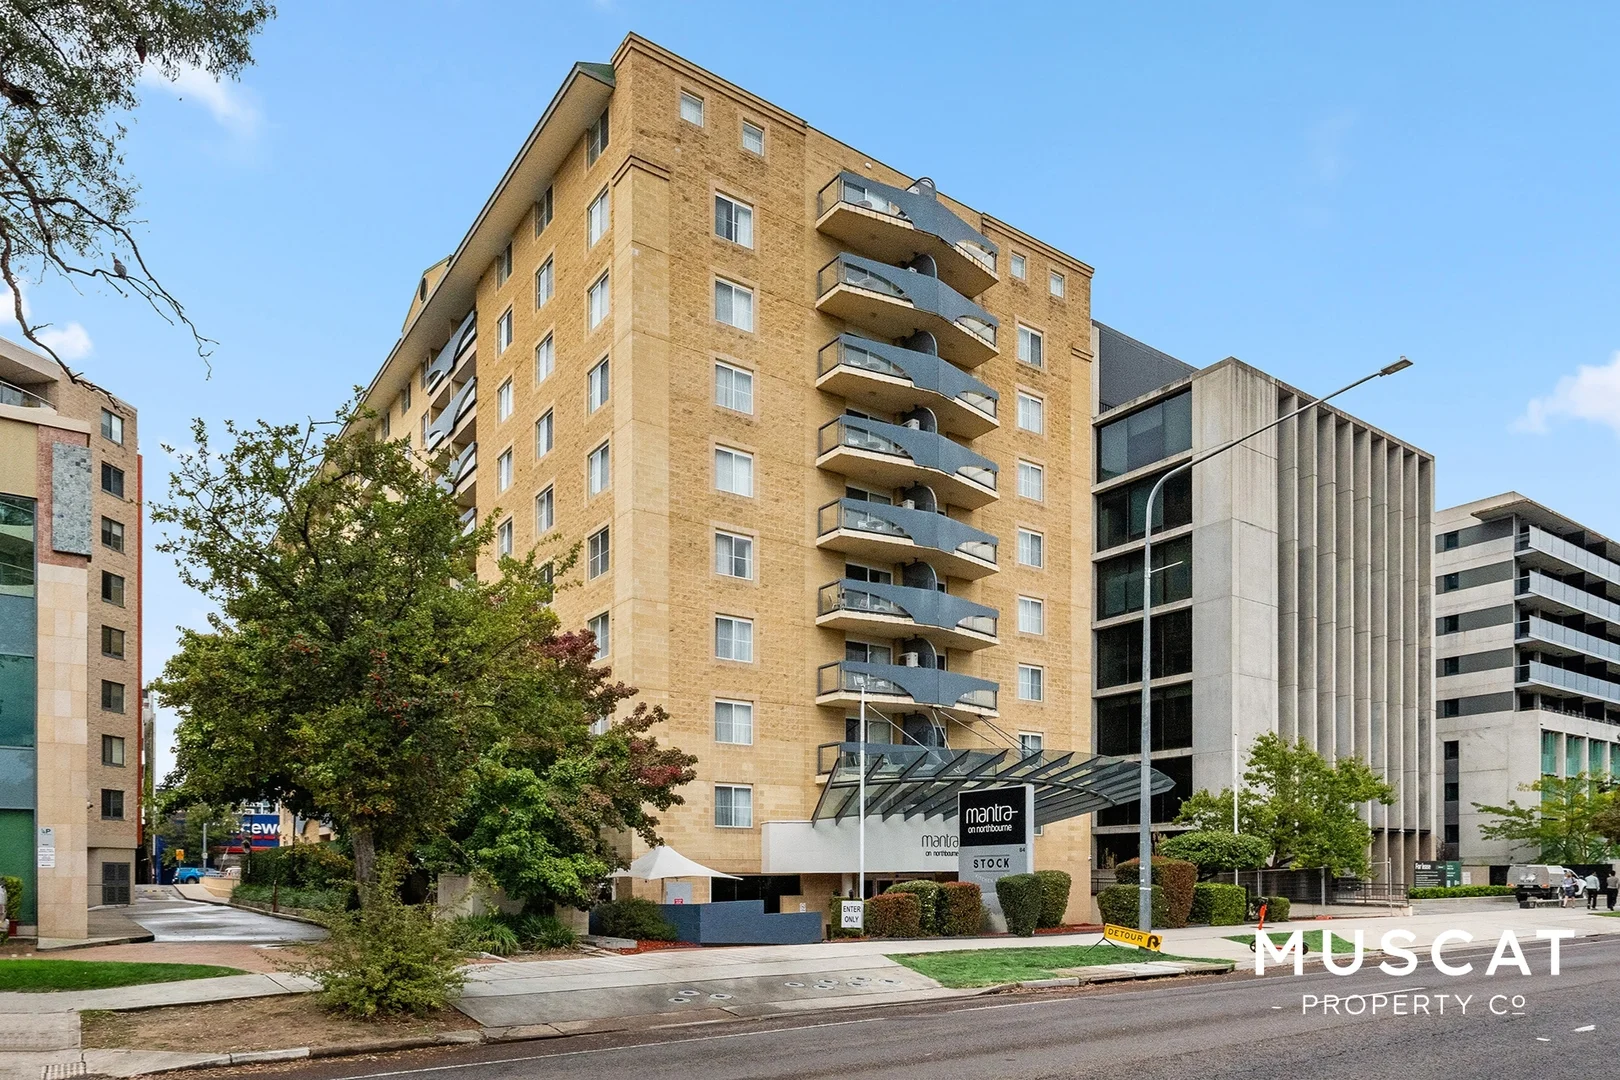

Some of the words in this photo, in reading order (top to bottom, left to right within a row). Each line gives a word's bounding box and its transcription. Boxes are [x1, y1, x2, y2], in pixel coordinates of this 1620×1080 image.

[966, 803, 1018, 824] mantra
[976, 824, 1012, 833] northbourne
[921, 834, 958, 847] mantra
[973, 858, 1010, 869] STOCK
[844, 915, 860, 923] ONLY
[1107, 928, 1144, 943] DETOUR
